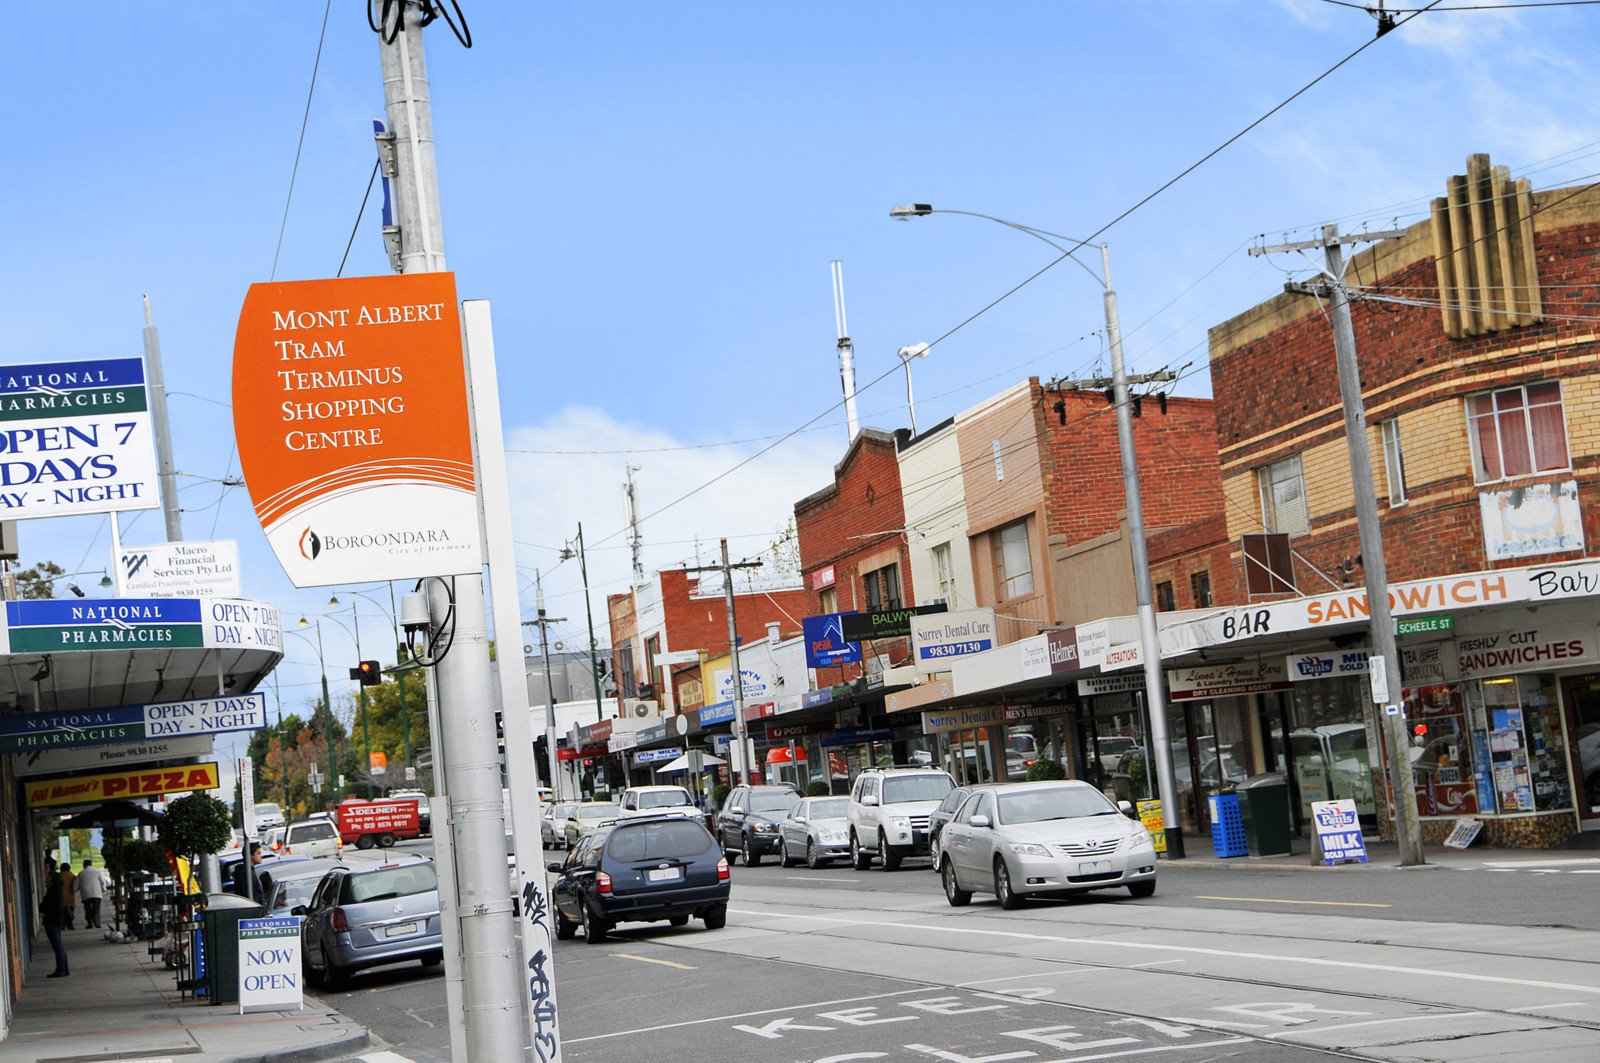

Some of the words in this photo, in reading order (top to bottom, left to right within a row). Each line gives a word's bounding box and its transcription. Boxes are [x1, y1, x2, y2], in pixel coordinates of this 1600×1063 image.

[273, 308, 349, 331] MONT
[356, 302, 444, 326] ALBERT
[274, 339, 346, 361] TRAM
[0, 370, 109, 389] ATIONAL
[278, 366, 403, 391] TERMINUS
[0, 391, 126, 411] ARMACIES
[282, 396, 405, 421] SHOPPING
[114, 422, 137, 446] 7
[285, 428, 383, 451] CENTRE
[0, 454, 118, 487] DAYS
[0, 491, 28, 509] AY
[53, 482, 144, 505] NIGHT
[324, 528, 450, 550] BOROONDARA
[175, 546, 207, 556] Macro
[389, 547, 410, 556] City
[413, 545, 426, 554] of
[428, 543, 472, 554] Harmony
[168, 555, 216, 566] Financial
[153, 568, 194, 578] Services
[197, 566, 213, 576] Pty
[215, 563, 232, 573] Ltd
[1529, 571, 1598, 596] Bar
[176, 589, 194, 597] 9830
[72, 606, 162, 619] NATIONAL
[213, 603, 250, 623] OPEN
[918, 628, 942, 642] Surrey
[945, 622, 970, 638] Dental
[972, 620, 990, 635] Care
[1223, 609, 1271, 639] BAR
[1399, 620, 1437, 633] SCHEELE
[1439, 619, 1450, 629] ST
[61, 629, 173, 644] PHARMACIES
[215, 625, 242, 643] DAY
[1459, 635, 1500, 651] FRESHLY
[1509, 631, 1538, 645] CUT
[812, 637, 833, 657] peak
[929, 645, 955, 657] 9830
[956, 642, 980, 654] 7130
[1049, 641, 1078, 664] Helmex
[1459, 640, 1584, 672] SANDWICHES
[1107, 648, 1137, 665] ALTERATIONS
[1342, 652, 1369, 663] MIL
[1225, 666, 1253, 677] Home
[1258, 662, 1282, 677] Care
[1303, 661, 1331, 674] Pauls
[1339, 663, 1363, 672] SOLD
[1123, 674, 1146, 682] Acces
[1204, 679, 1232, 687] Laundry
[1210, 686, 1245, 695] CLEANING
[1248, 683, 1272, 692] AGENT
[149, 703, 195, 720] OPEN
[200, 703, 208, 714] 7
[215, 697, 256, 713] DAYS
[1006, 708, 1026, 720] MEN'S
[1027, 703, 1076, 717] HAIRDRESSING
[28, 713, 114, 729] NATIONAL
[150, 720, 183, 735] DAY
[200, 712, 257, 731] NIGHT
[929, 715, 957, 728] Surrey
[961, 709, 990, 724] Dental
[17, 728, 126, 747] PHARMACIES
[783, 726, 808, 736] POST
[100, 750, 126, 760] Phone
[127, 747, 147, 757] 9830
[149, 745, 168, 755] 1255
[102, 768, 211, 797] PIZZA
[343, 804, 398, 817] SIDELINER
[1321, 812, 1353, 825] Pauls
[1322, 833, 1361, 851] MILK
[1324, 850, 1344, 859] SOLD
[1344, 849, 1365, 858] HERE
[241, 928, 298, 936] PHARMACIES
[247, 920, 292, 928] NATIONAL
[246, 948, 294, 966] NOW
[244, 973, 297, 991] OPEN
[731, 987, 1056, 1039] KEEP
